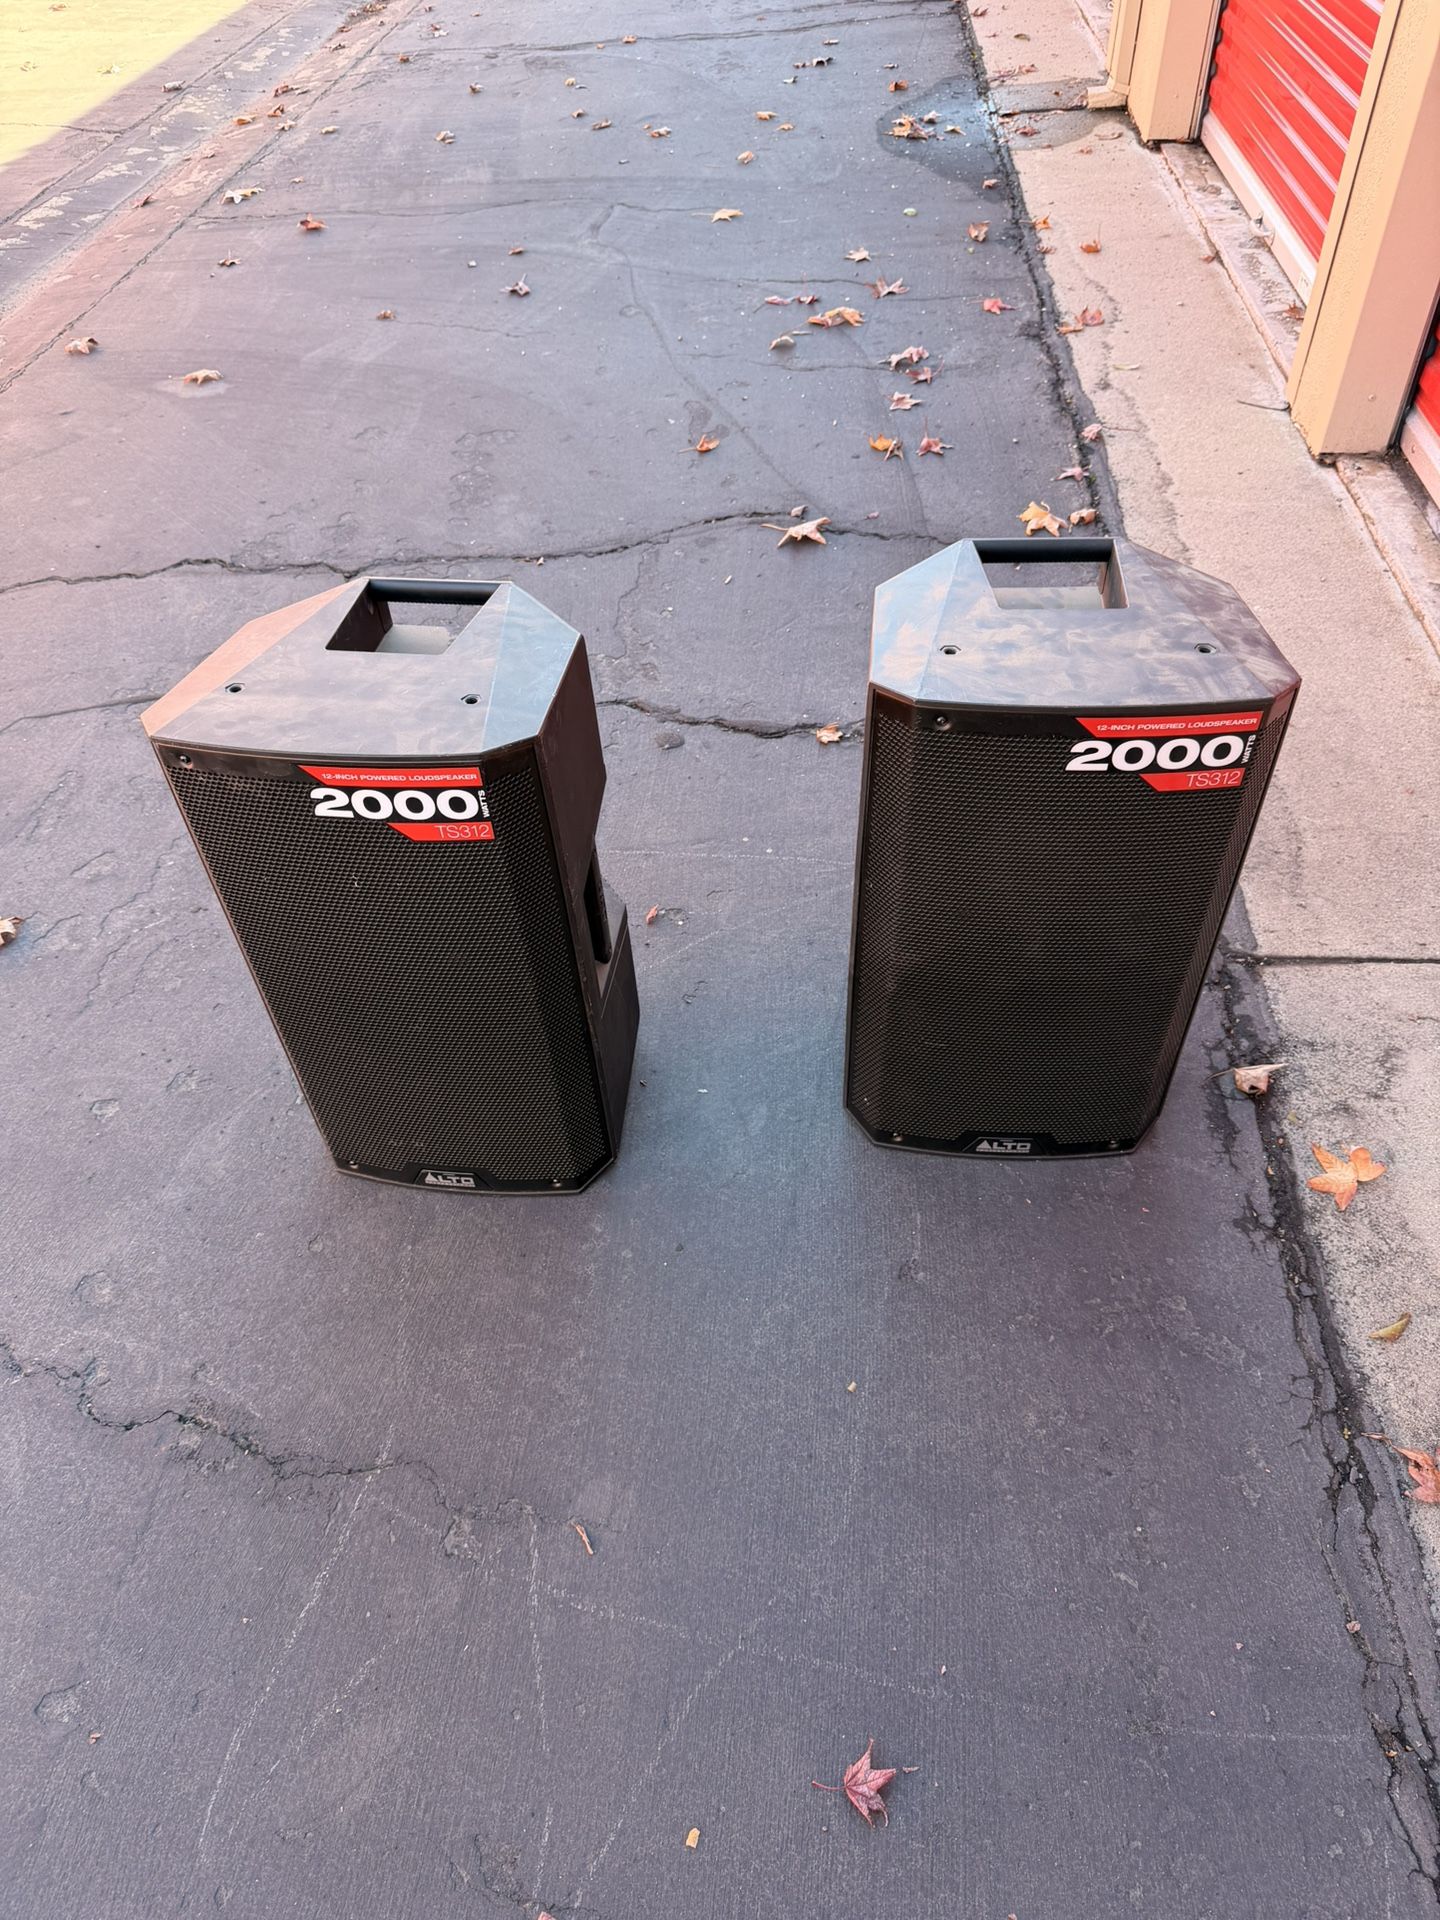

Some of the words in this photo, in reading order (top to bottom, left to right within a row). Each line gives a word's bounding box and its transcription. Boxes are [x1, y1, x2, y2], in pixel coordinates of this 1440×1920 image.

[1137, 722, 1186, 730] POWERED
[1187, 718, 1257, 729] LOUDSPEAKER
[1065, 735, 1244, 772] 2000
[1240, 734, 1257, 764] WATTS
[360, 774, 406, 782] POWERED
[408, 774, 477, 782] LOUDSPEAKER
[1186, 772, 1241, 787] TS312
[310, 787, 479, 821] 2000
[478, 789, 490, 818] WATTS
[434, 825, 490, 839] TS312
[975, 1139, 1031, 1152] ALTO
[425, 1172, 475, 1187] ALTO
